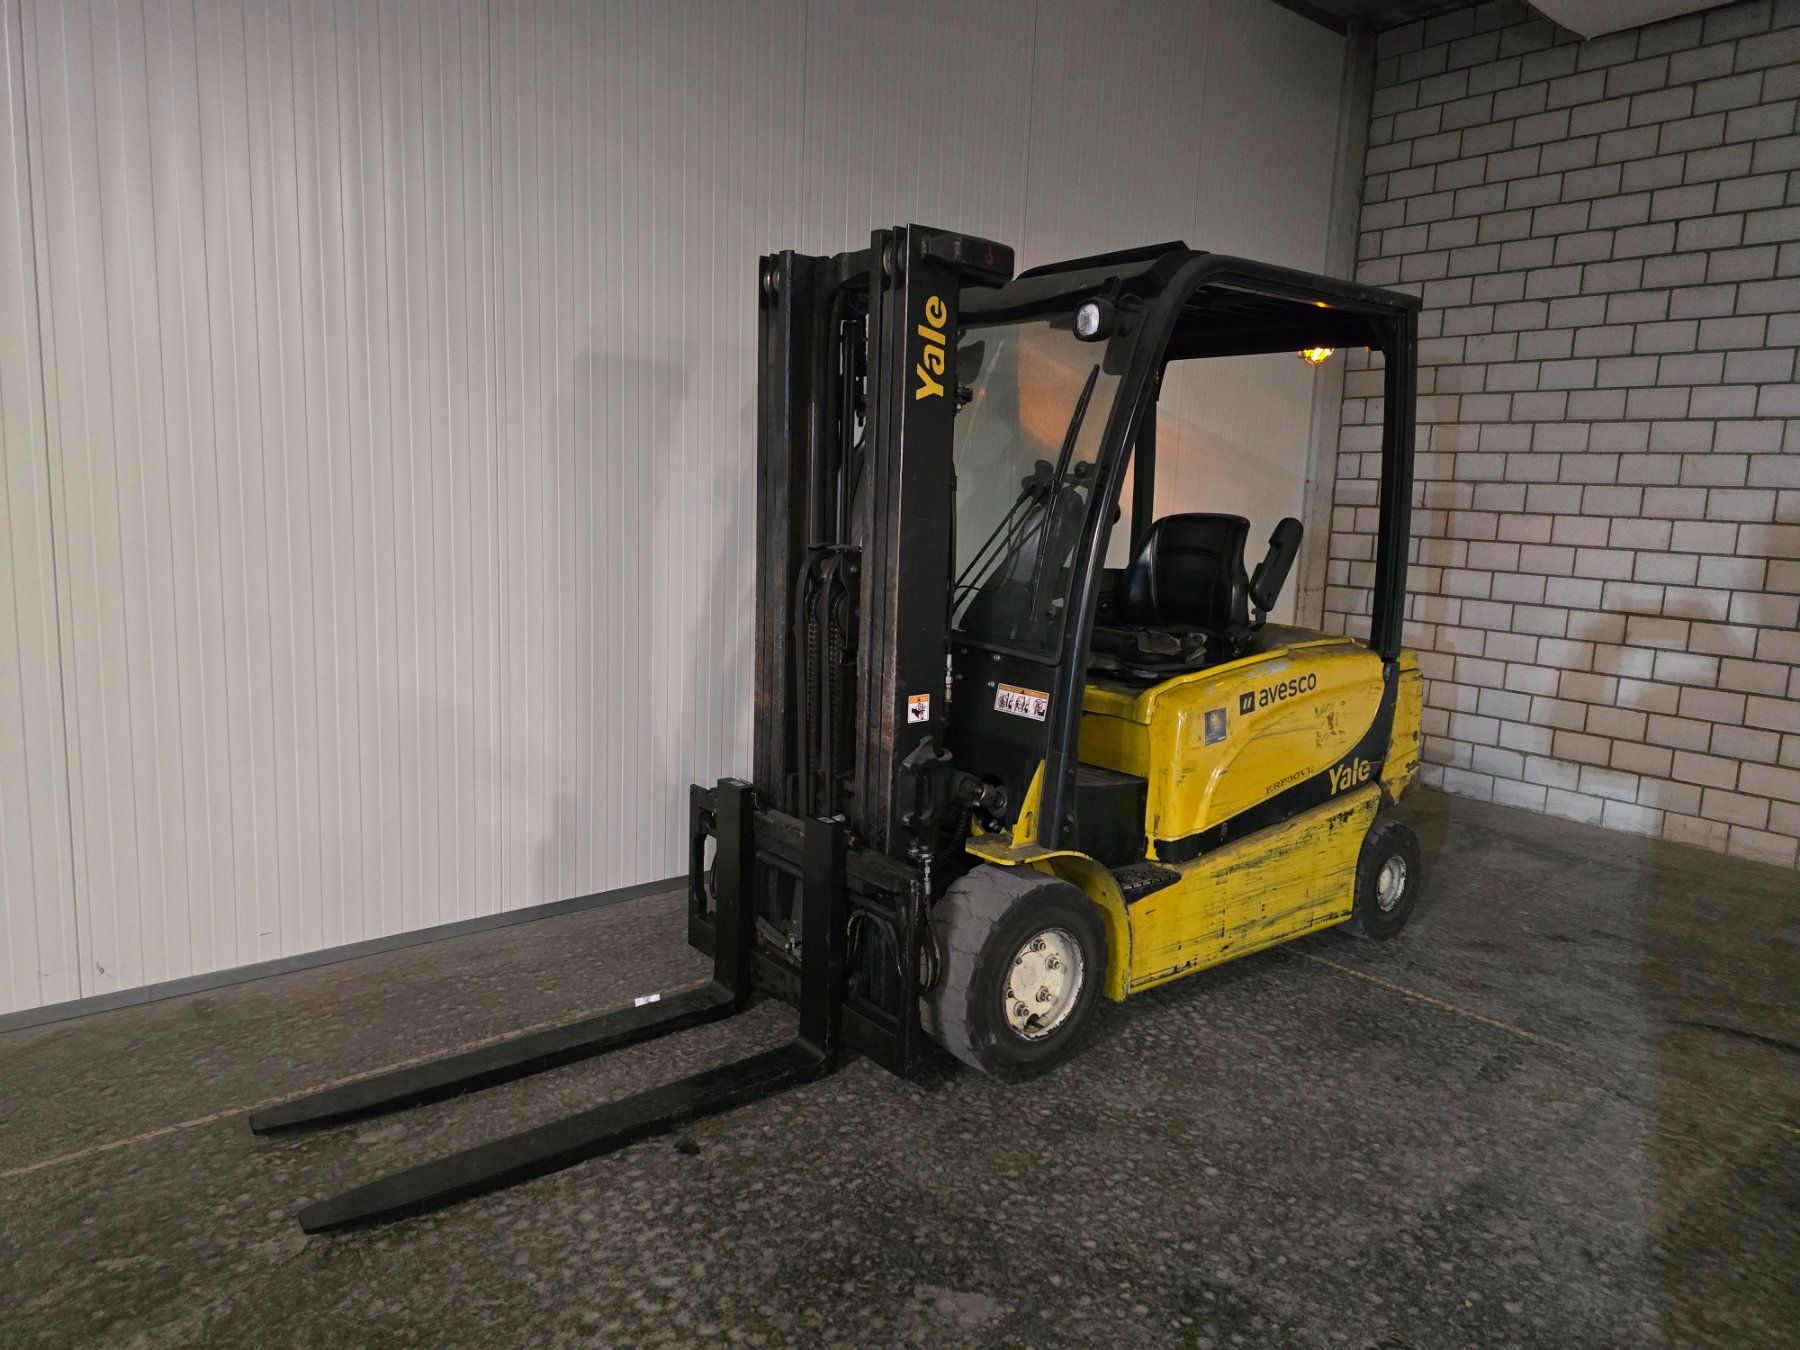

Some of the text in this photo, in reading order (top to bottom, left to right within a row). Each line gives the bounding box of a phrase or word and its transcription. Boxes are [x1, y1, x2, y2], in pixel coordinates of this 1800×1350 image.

[915, 295, 948, 400] Yale
[1259, 673, 1317, 707] avesco
[1329, 757, 1371, 795] Yale
